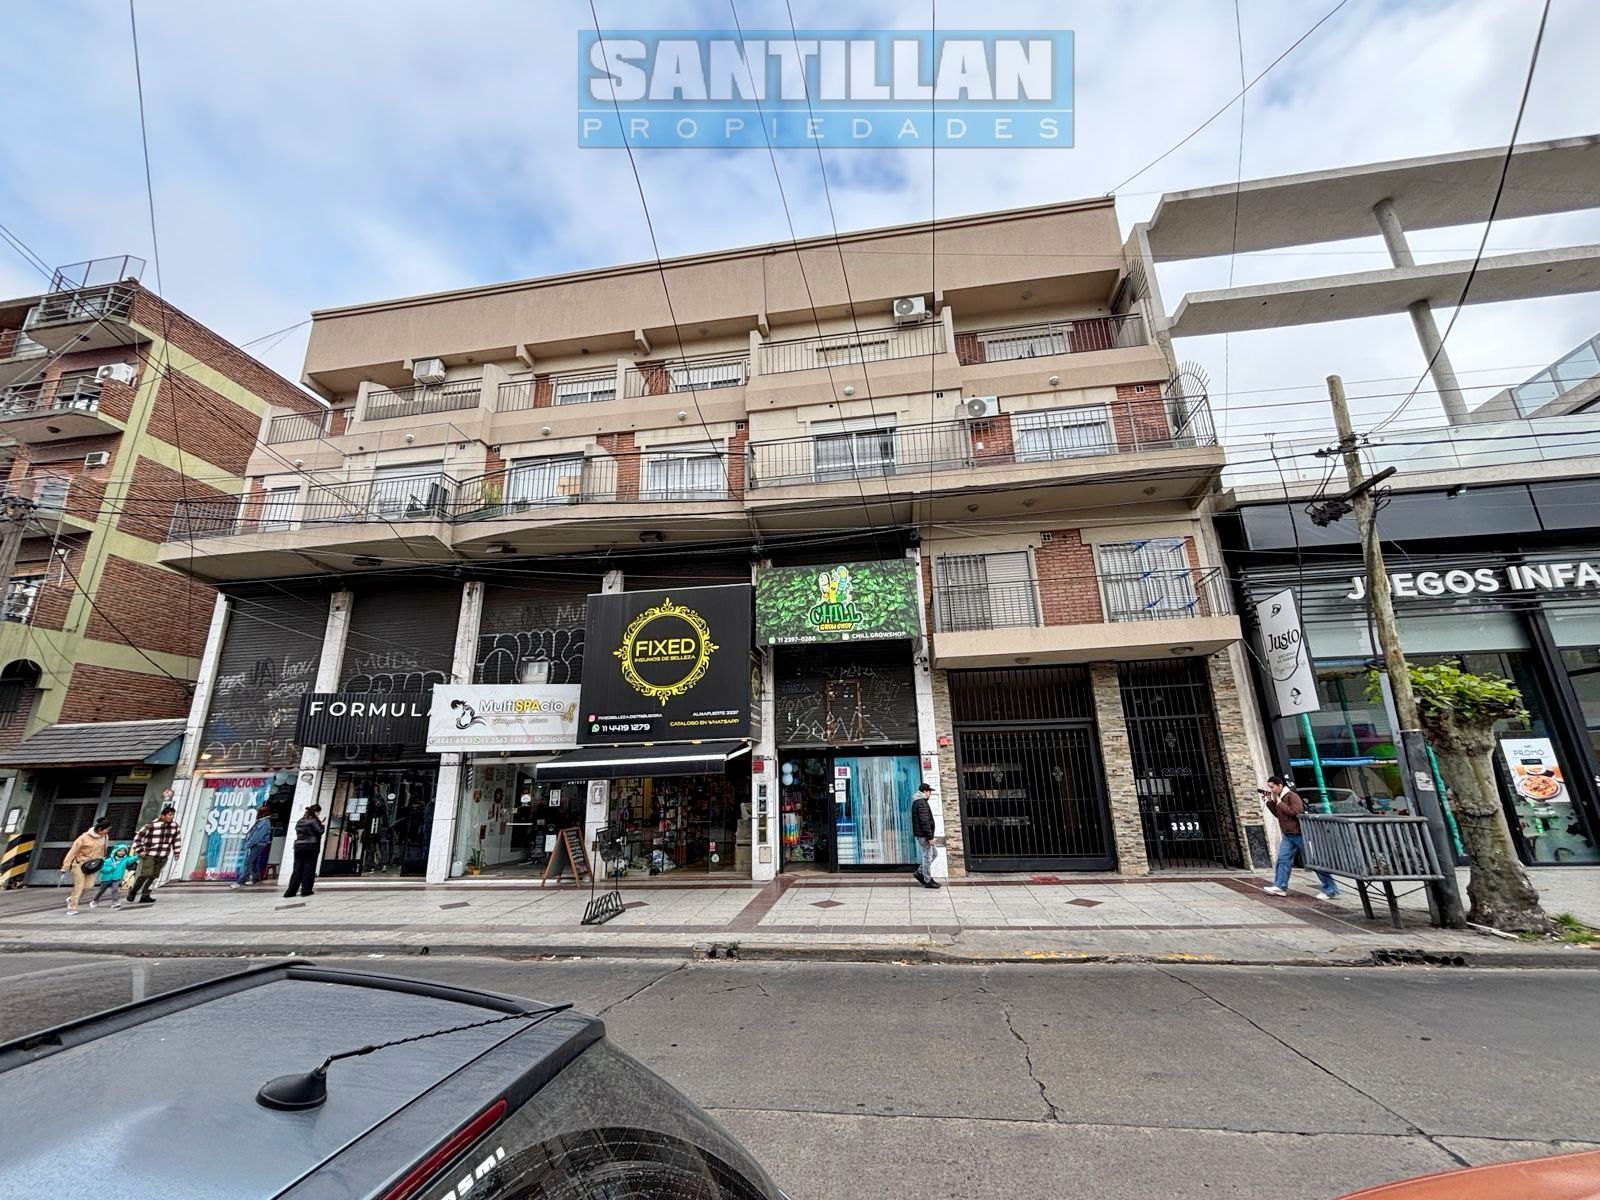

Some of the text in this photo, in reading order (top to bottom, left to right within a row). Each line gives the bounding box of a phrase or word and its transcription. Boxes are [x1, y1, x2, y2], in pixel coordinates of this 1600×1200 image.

[810, 601, 863, 624] CHILL
[635, 638, 696, 657] FIXED
[1268, 628, 1300, 652] Justo
[479, 698, 564, 714] MultiSPAcio
[609, 724, 629, 732] 4419
[630, 723, 651, 731] 1279
[1512, 749, 1545, 757] PROMO
[214, 791, 243, 807] TODO
[205, 807, 258, 836] $999
